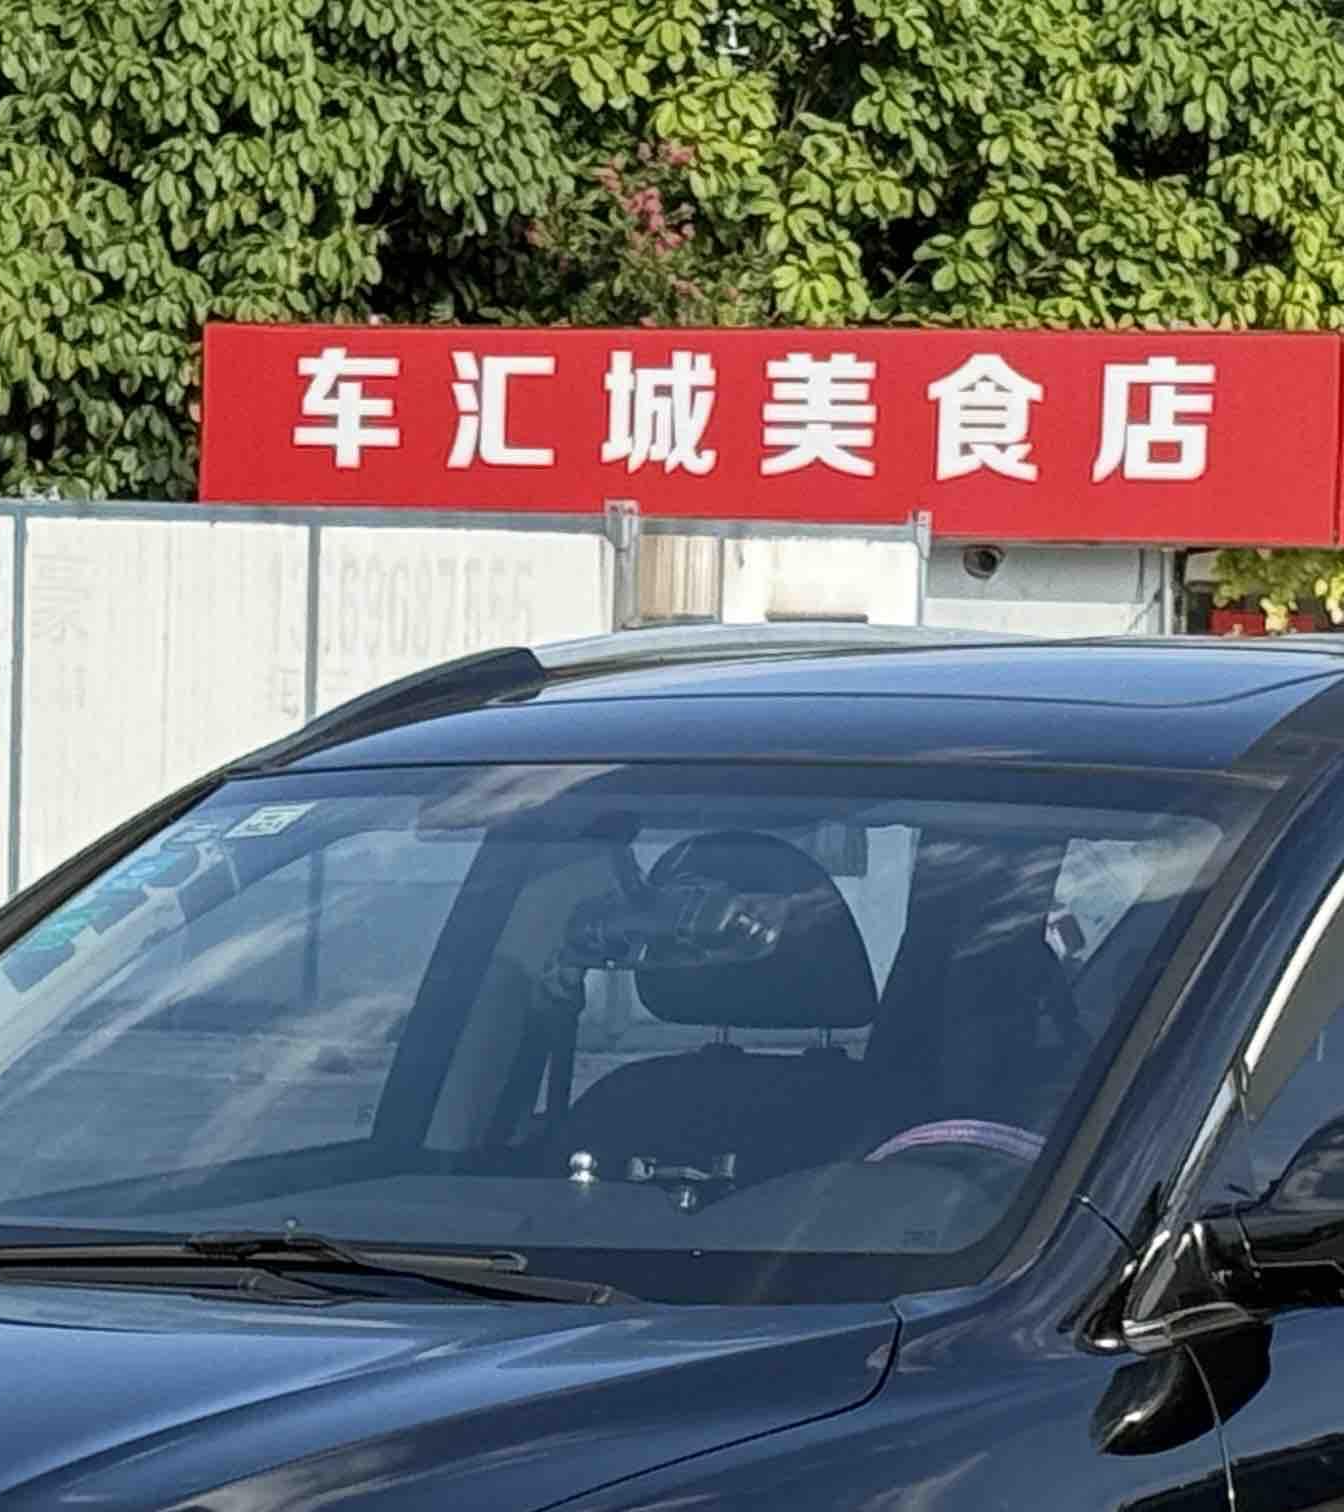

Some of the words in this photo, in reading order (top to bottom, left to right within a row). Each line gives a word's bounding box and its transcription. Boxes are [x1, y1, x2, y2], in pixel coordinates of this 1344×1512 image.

[293, 346, 1218, 484] 车汇城美食店
